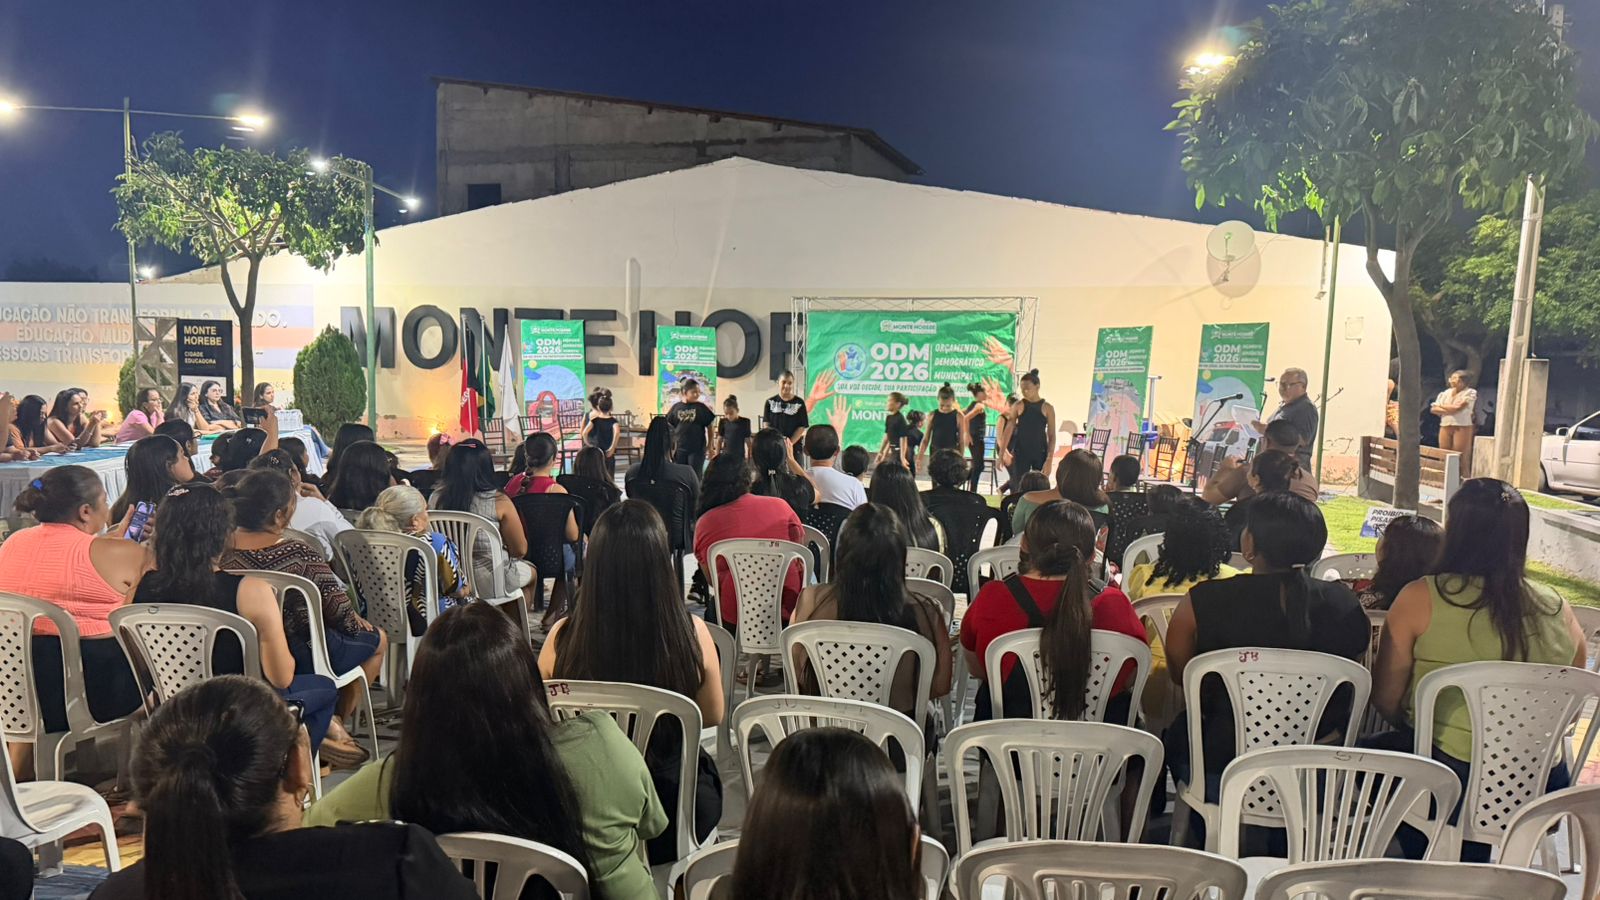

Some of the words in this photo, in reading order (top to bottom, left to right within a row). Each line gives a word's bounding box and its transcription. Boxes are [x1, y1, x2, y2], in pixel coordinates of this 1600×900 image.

[0, 304, 52, 325] CAÇÃO
[56, 304, 88, 323] NÃO
[18, 324, 94, 346] EDUCAÇÃO
[102, 327, 134, 344] MUD
[183, 325, 217, 335] MONTE
[183, 335, 223, 346] HOREBE
[536, 338, 562, 346] ODM
[674, 345, 699, 353] ODM
[870, 342, 930, 361] ODM
[935, 343, 979, 354] ORÇAMENTO
[1214, 344, 1241, 353] ODM
[0, 346, 49, 362] SSOAS
[54, 347, 132, 364] TRANSFOR
[1105, 350, 1128, 358] ODM
[1213, 353, 1239, 362] 2026
[184, 357, 217, 365] EDUCADORA
[934, 356, 985, 367] DEMOCRÁTICO
[1104, 358, 1127, 366] 2026
[870, 362, 929, 381] 2026
[934, 371, 974, 381] MUNICIPAL
[852, 409, 890, 421] MONT
